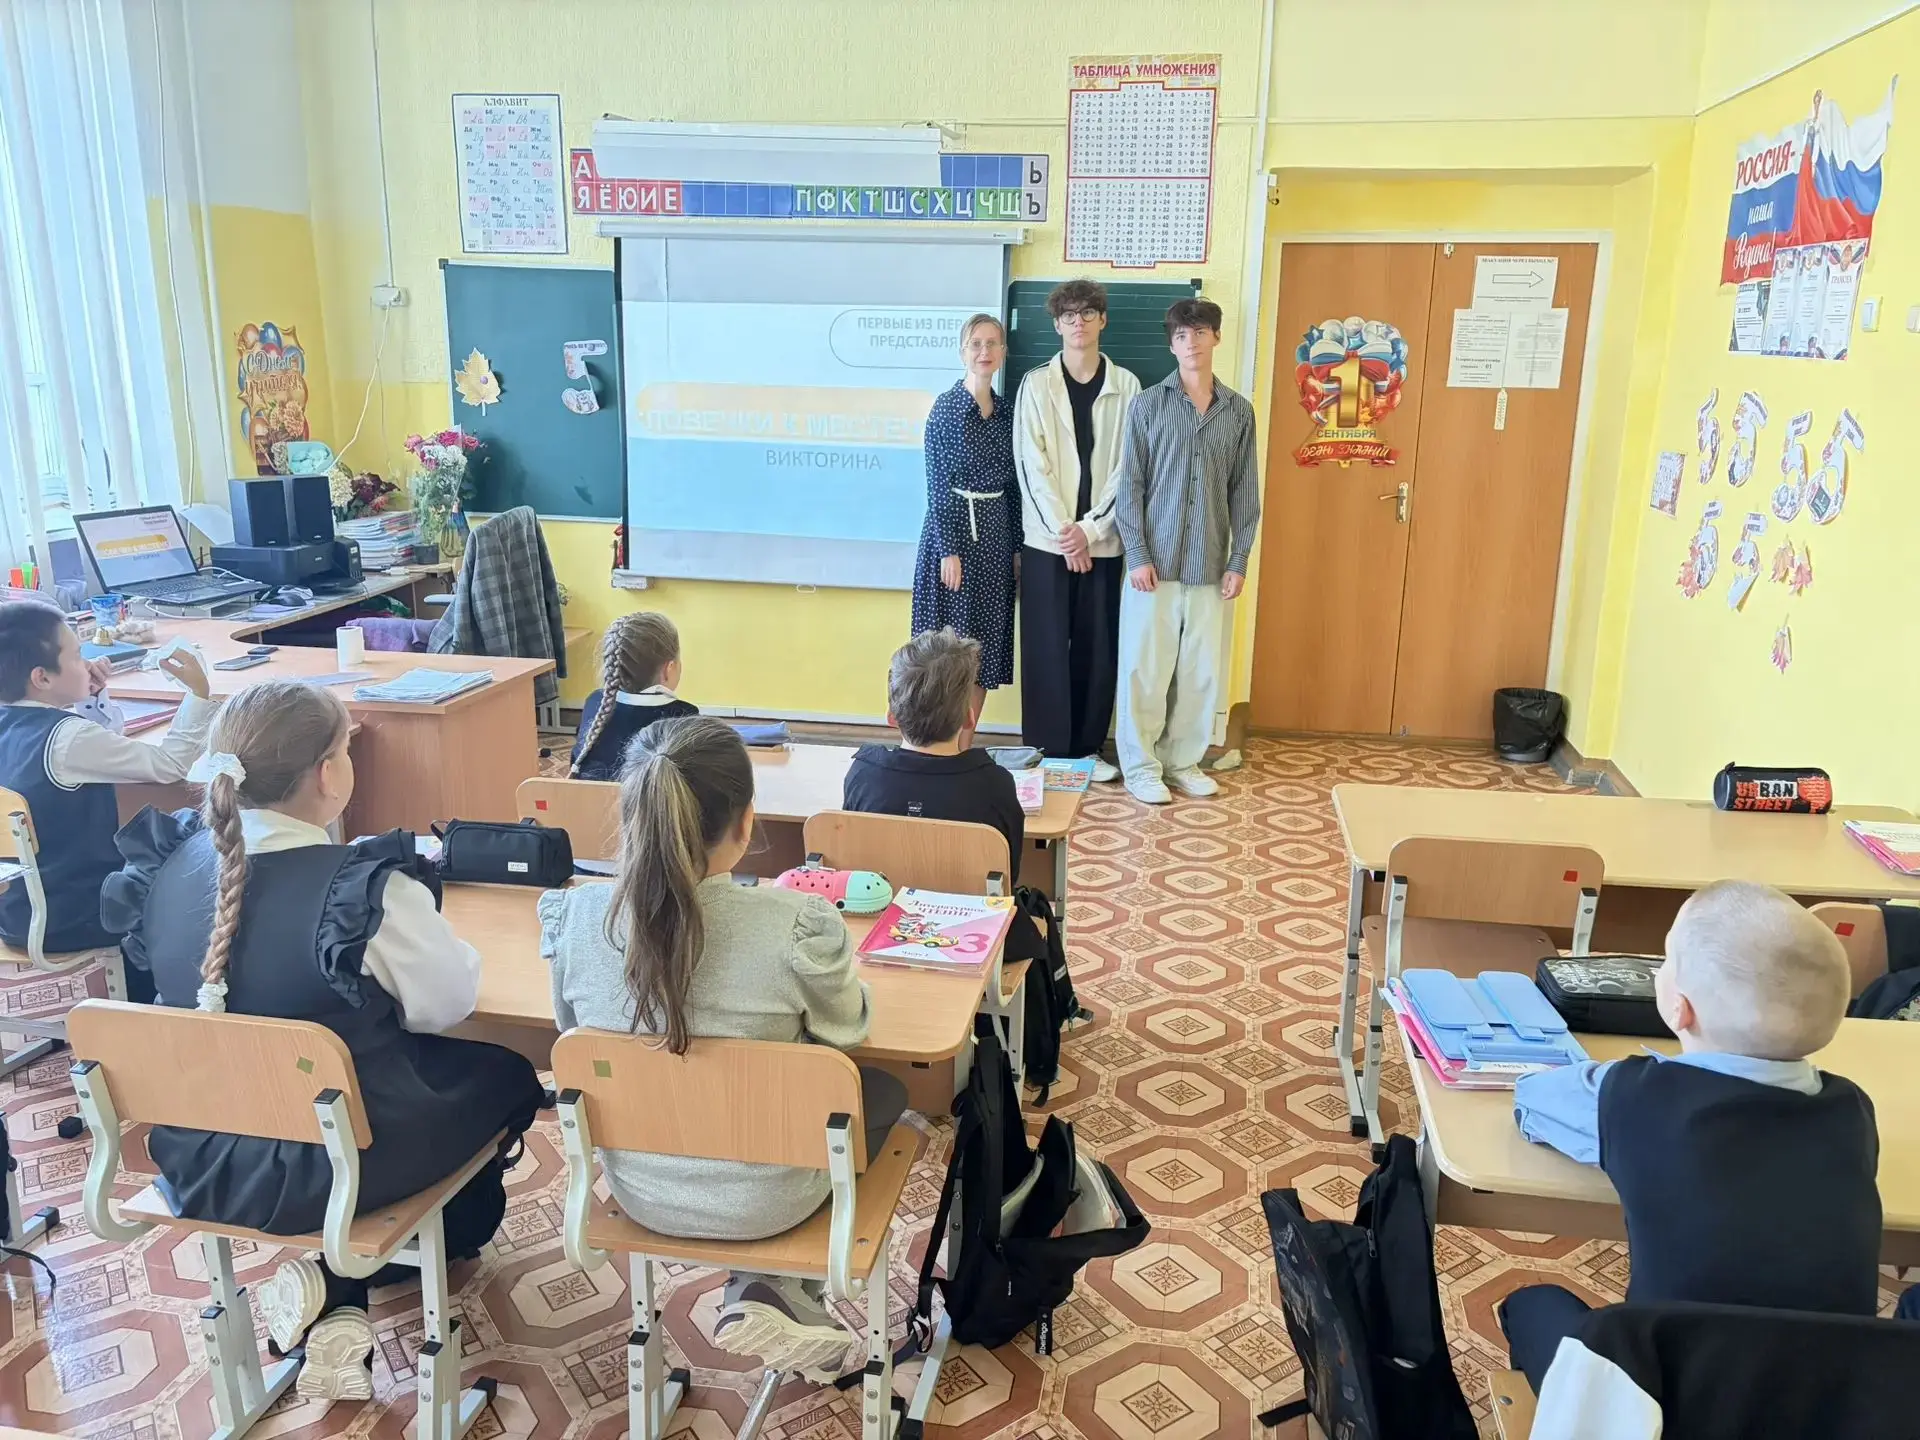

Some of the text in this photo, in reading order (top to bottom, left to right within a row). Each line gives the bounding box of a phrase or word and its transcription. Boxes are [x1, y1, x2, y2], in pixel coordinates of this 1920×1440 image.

[1073, 63, 1216, 78] ТАБЛИЦА УМНОЖЕНИЯ
[483, 98, 529, 106] АЛФАВИТ
[575, 155, 592, 179] А
[1747, 200, 1774, 225] наша
[1733, 227, 1776, 279] Родина!
[858, 317, 962, 331] ПЕРВЫЕ ИЗ ПЕР
[870, 334, 958, 350] ПРЕДСТАВЛЯ
[1329, 356, 1361, 428] 1
[1316, 429, 1377, 438] СЕНТЯБРЯ
[766, 449, 883, 471] ВИКТОРИНА
[1736, 780, 1795, 798] URBAN
[1733, 798, 1794, 811] STREET
[954, 932, 990, 954] 3
